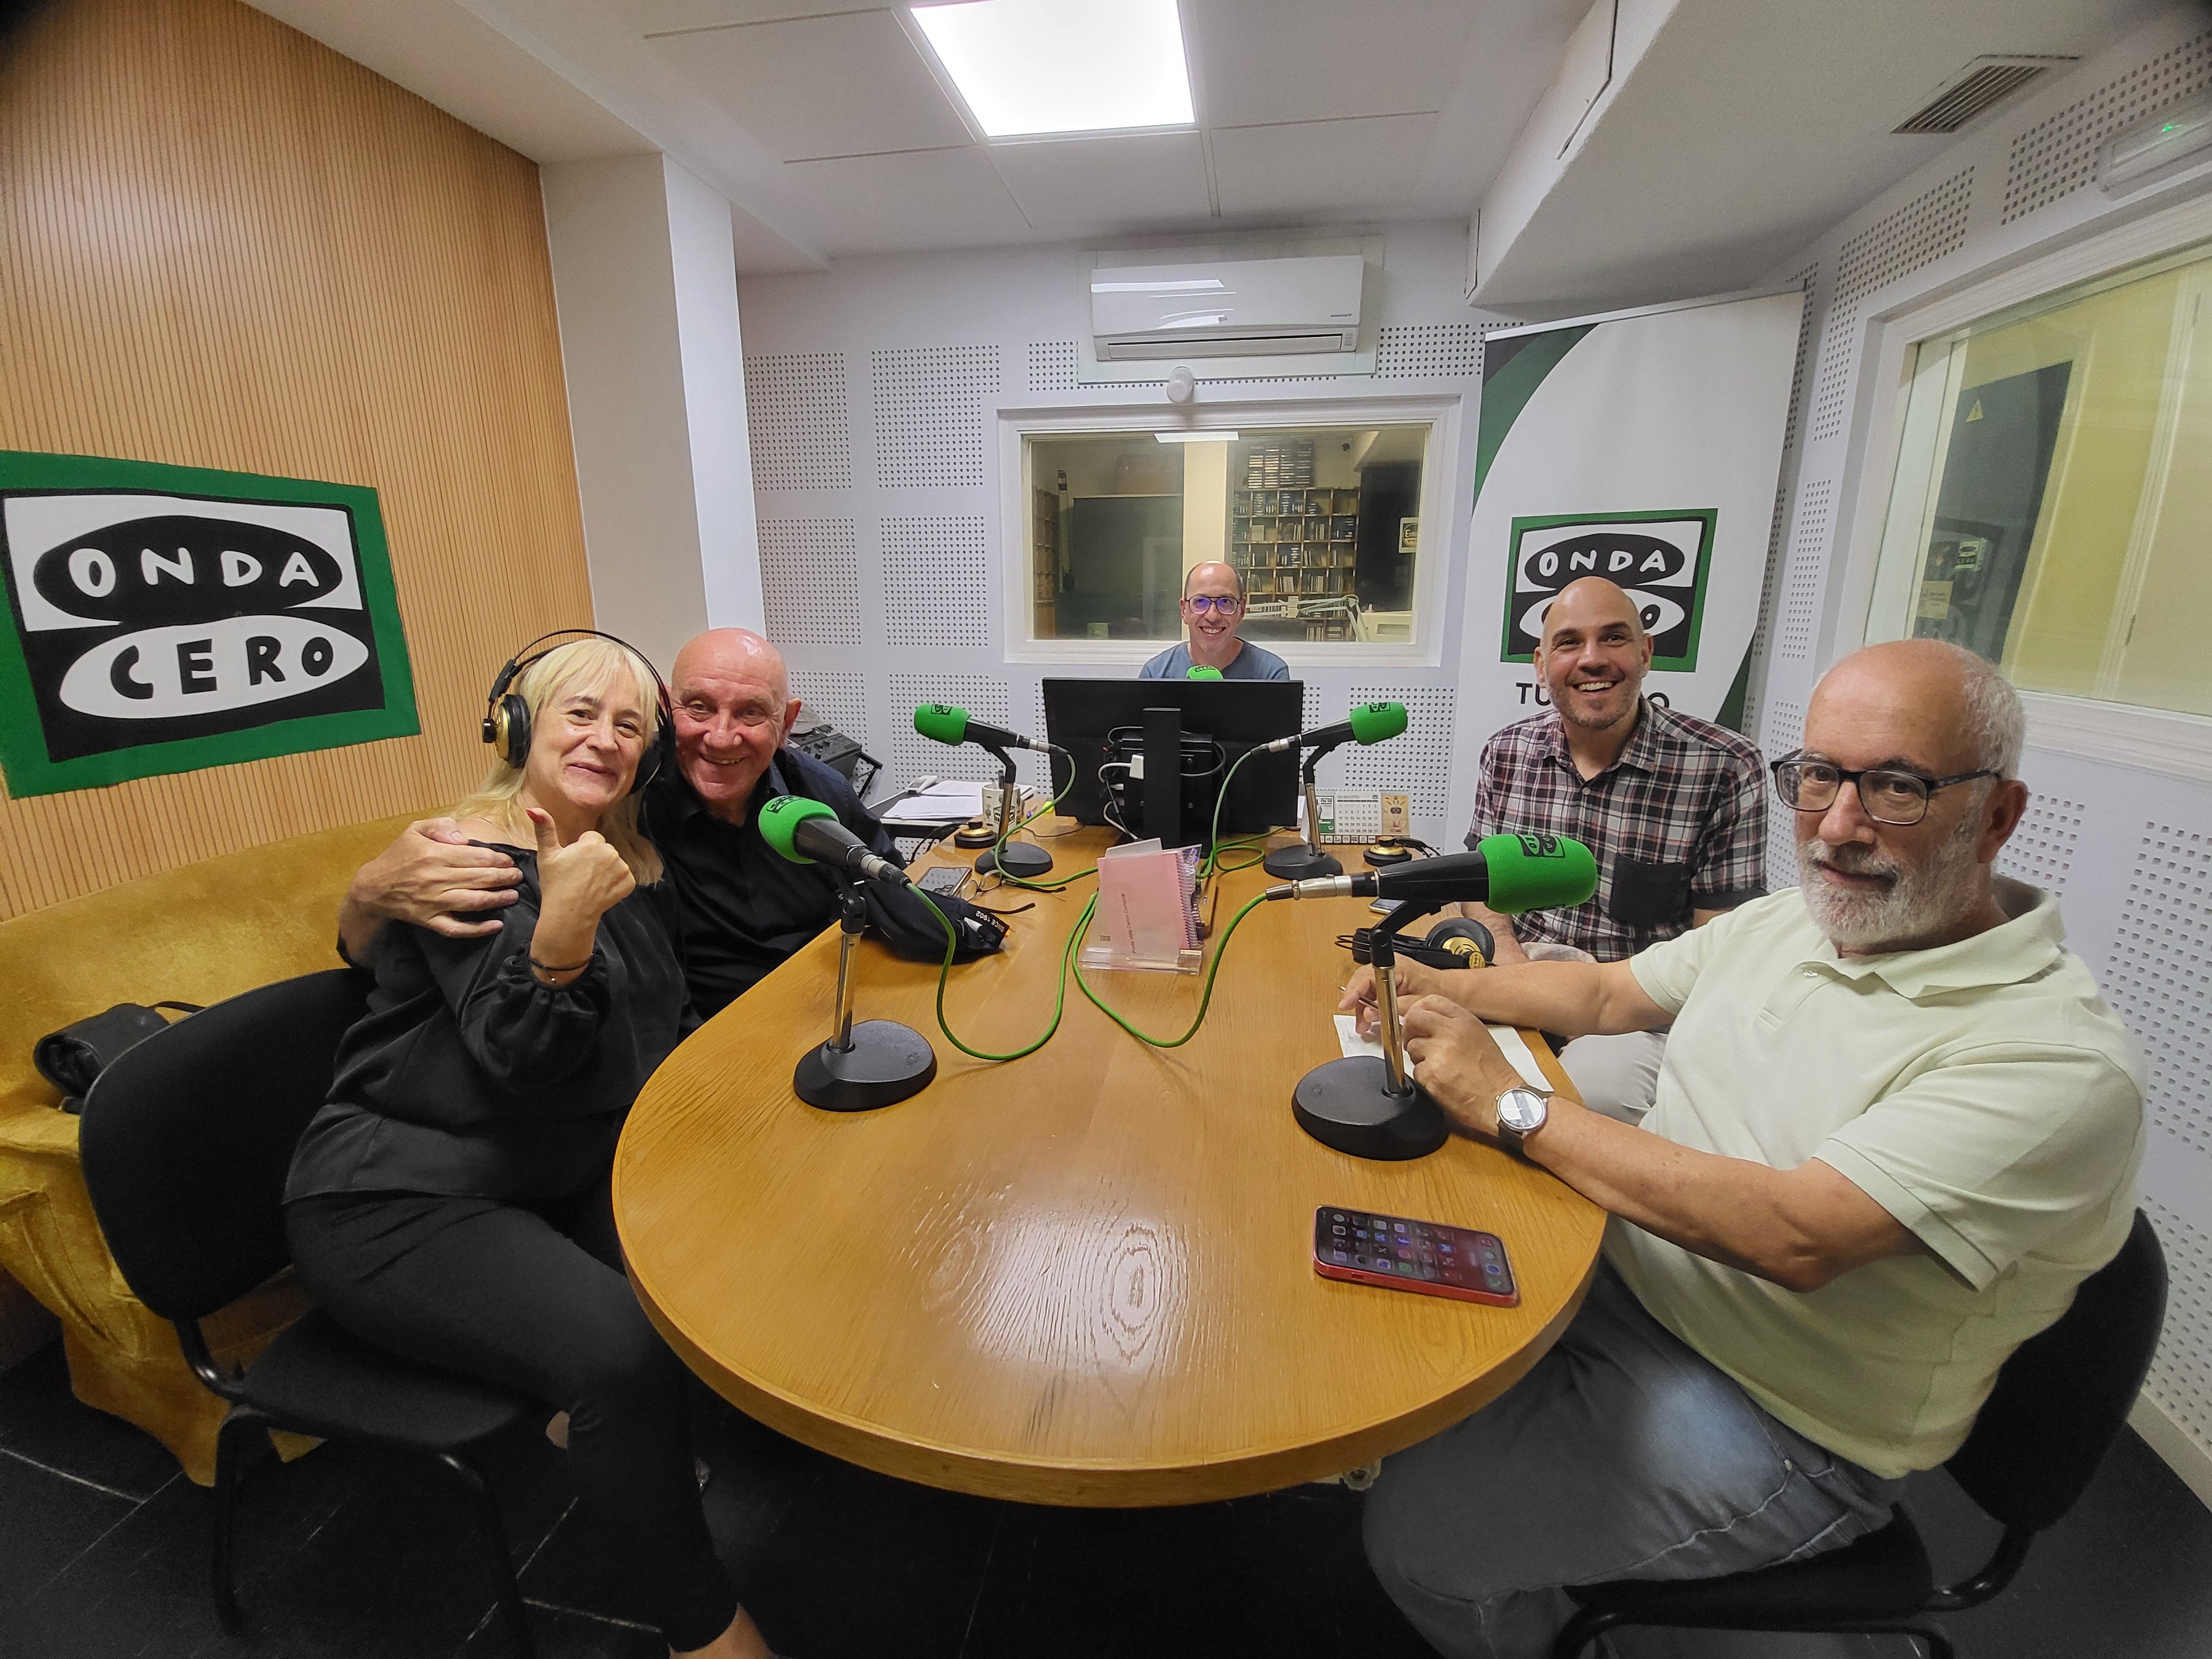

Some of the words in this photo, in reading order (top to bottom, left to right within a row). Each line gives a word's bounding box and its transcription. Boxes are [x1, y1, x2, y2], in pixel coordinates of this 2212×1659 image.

[68, 547, 319, 598] ONDA
[1538, 549, 1666, 577] ONDA
[110, 635, 333, 700] CERO
[1516, 682, 1551, 706] TU
[975, 910, 991, 922] 1902
